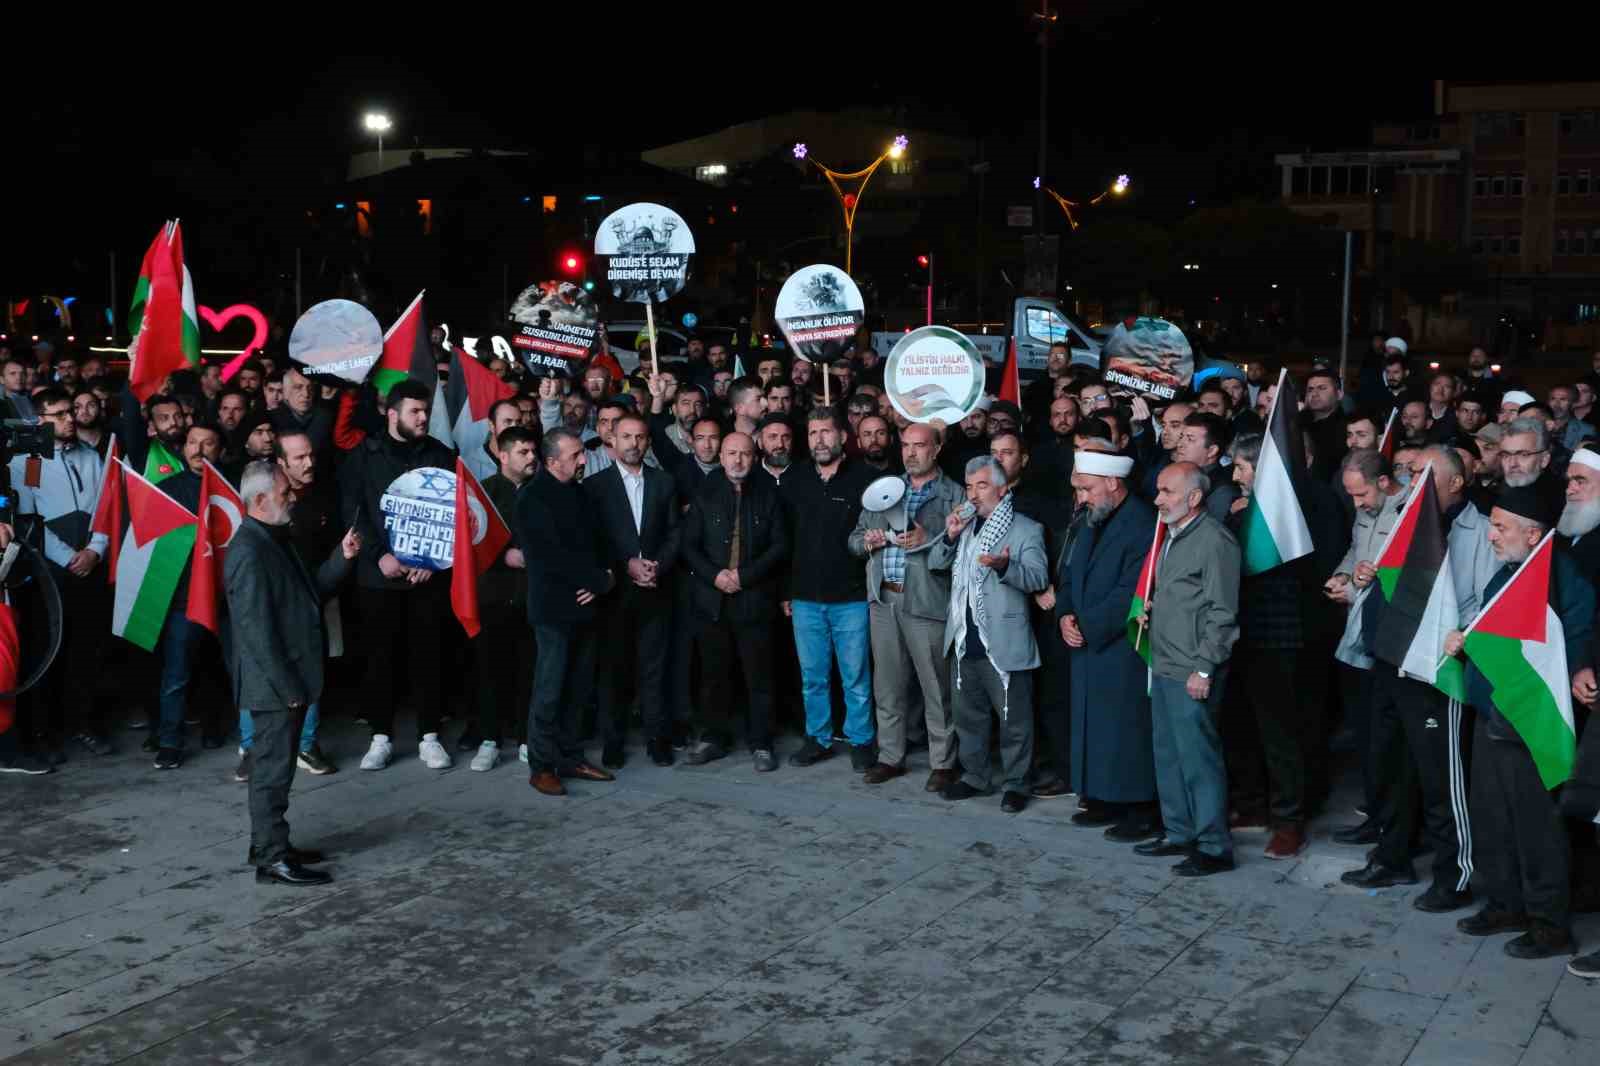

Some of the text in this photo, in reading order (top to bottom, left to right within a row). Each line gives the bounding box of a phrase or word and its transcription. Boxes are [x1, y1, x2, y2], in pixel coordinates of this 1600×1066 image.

[649, 257, 679, 267] SELAM
[651, 269, 681, 280] DEVAM
[529, 353, 541, 364] YA
[1105, 370, 1176, 399] SİYONİZME LANET
[385, 498, 455, 523] SİYONİST İS
[384, 515, 454, 541] FİLİSTİN'D
